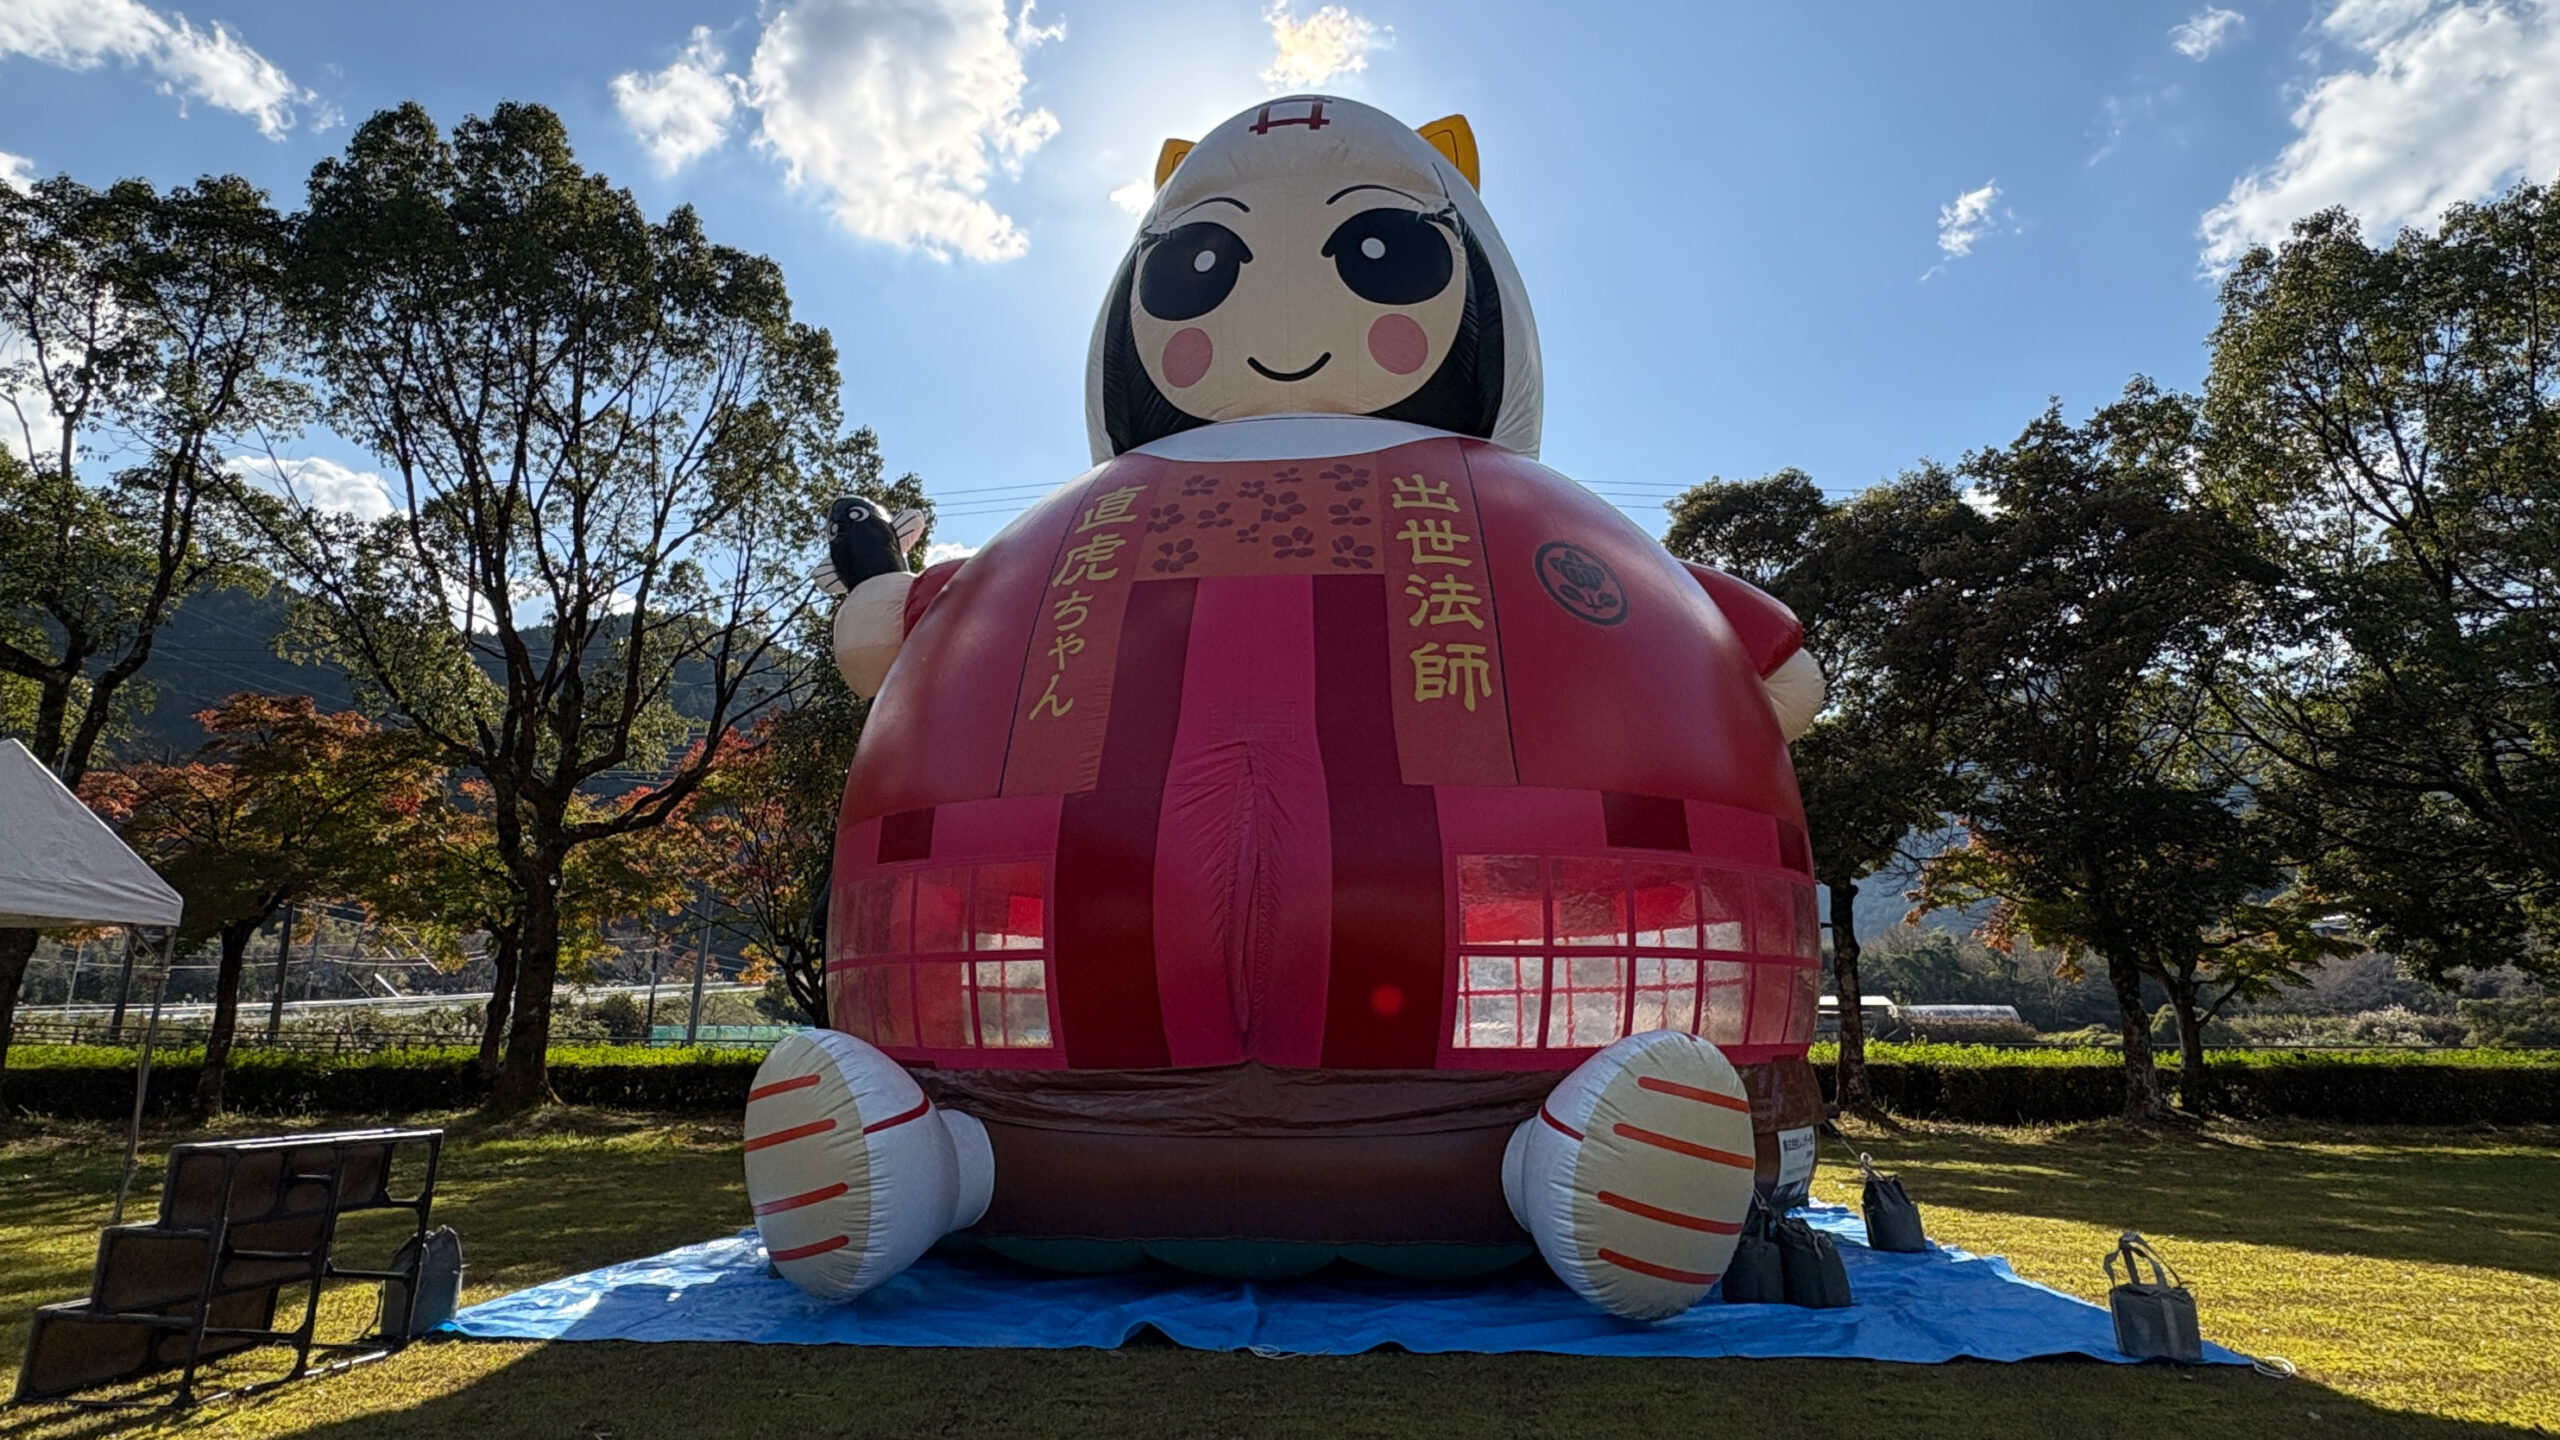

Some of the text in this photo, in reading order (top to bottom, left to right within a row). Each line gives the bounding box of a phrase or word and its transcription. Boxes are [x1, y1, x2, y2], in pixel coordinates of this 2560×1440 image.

[1029, 485, 1147, 719] 直虎ちゃん
[1391, 474, 1492, 711] 出世法師
